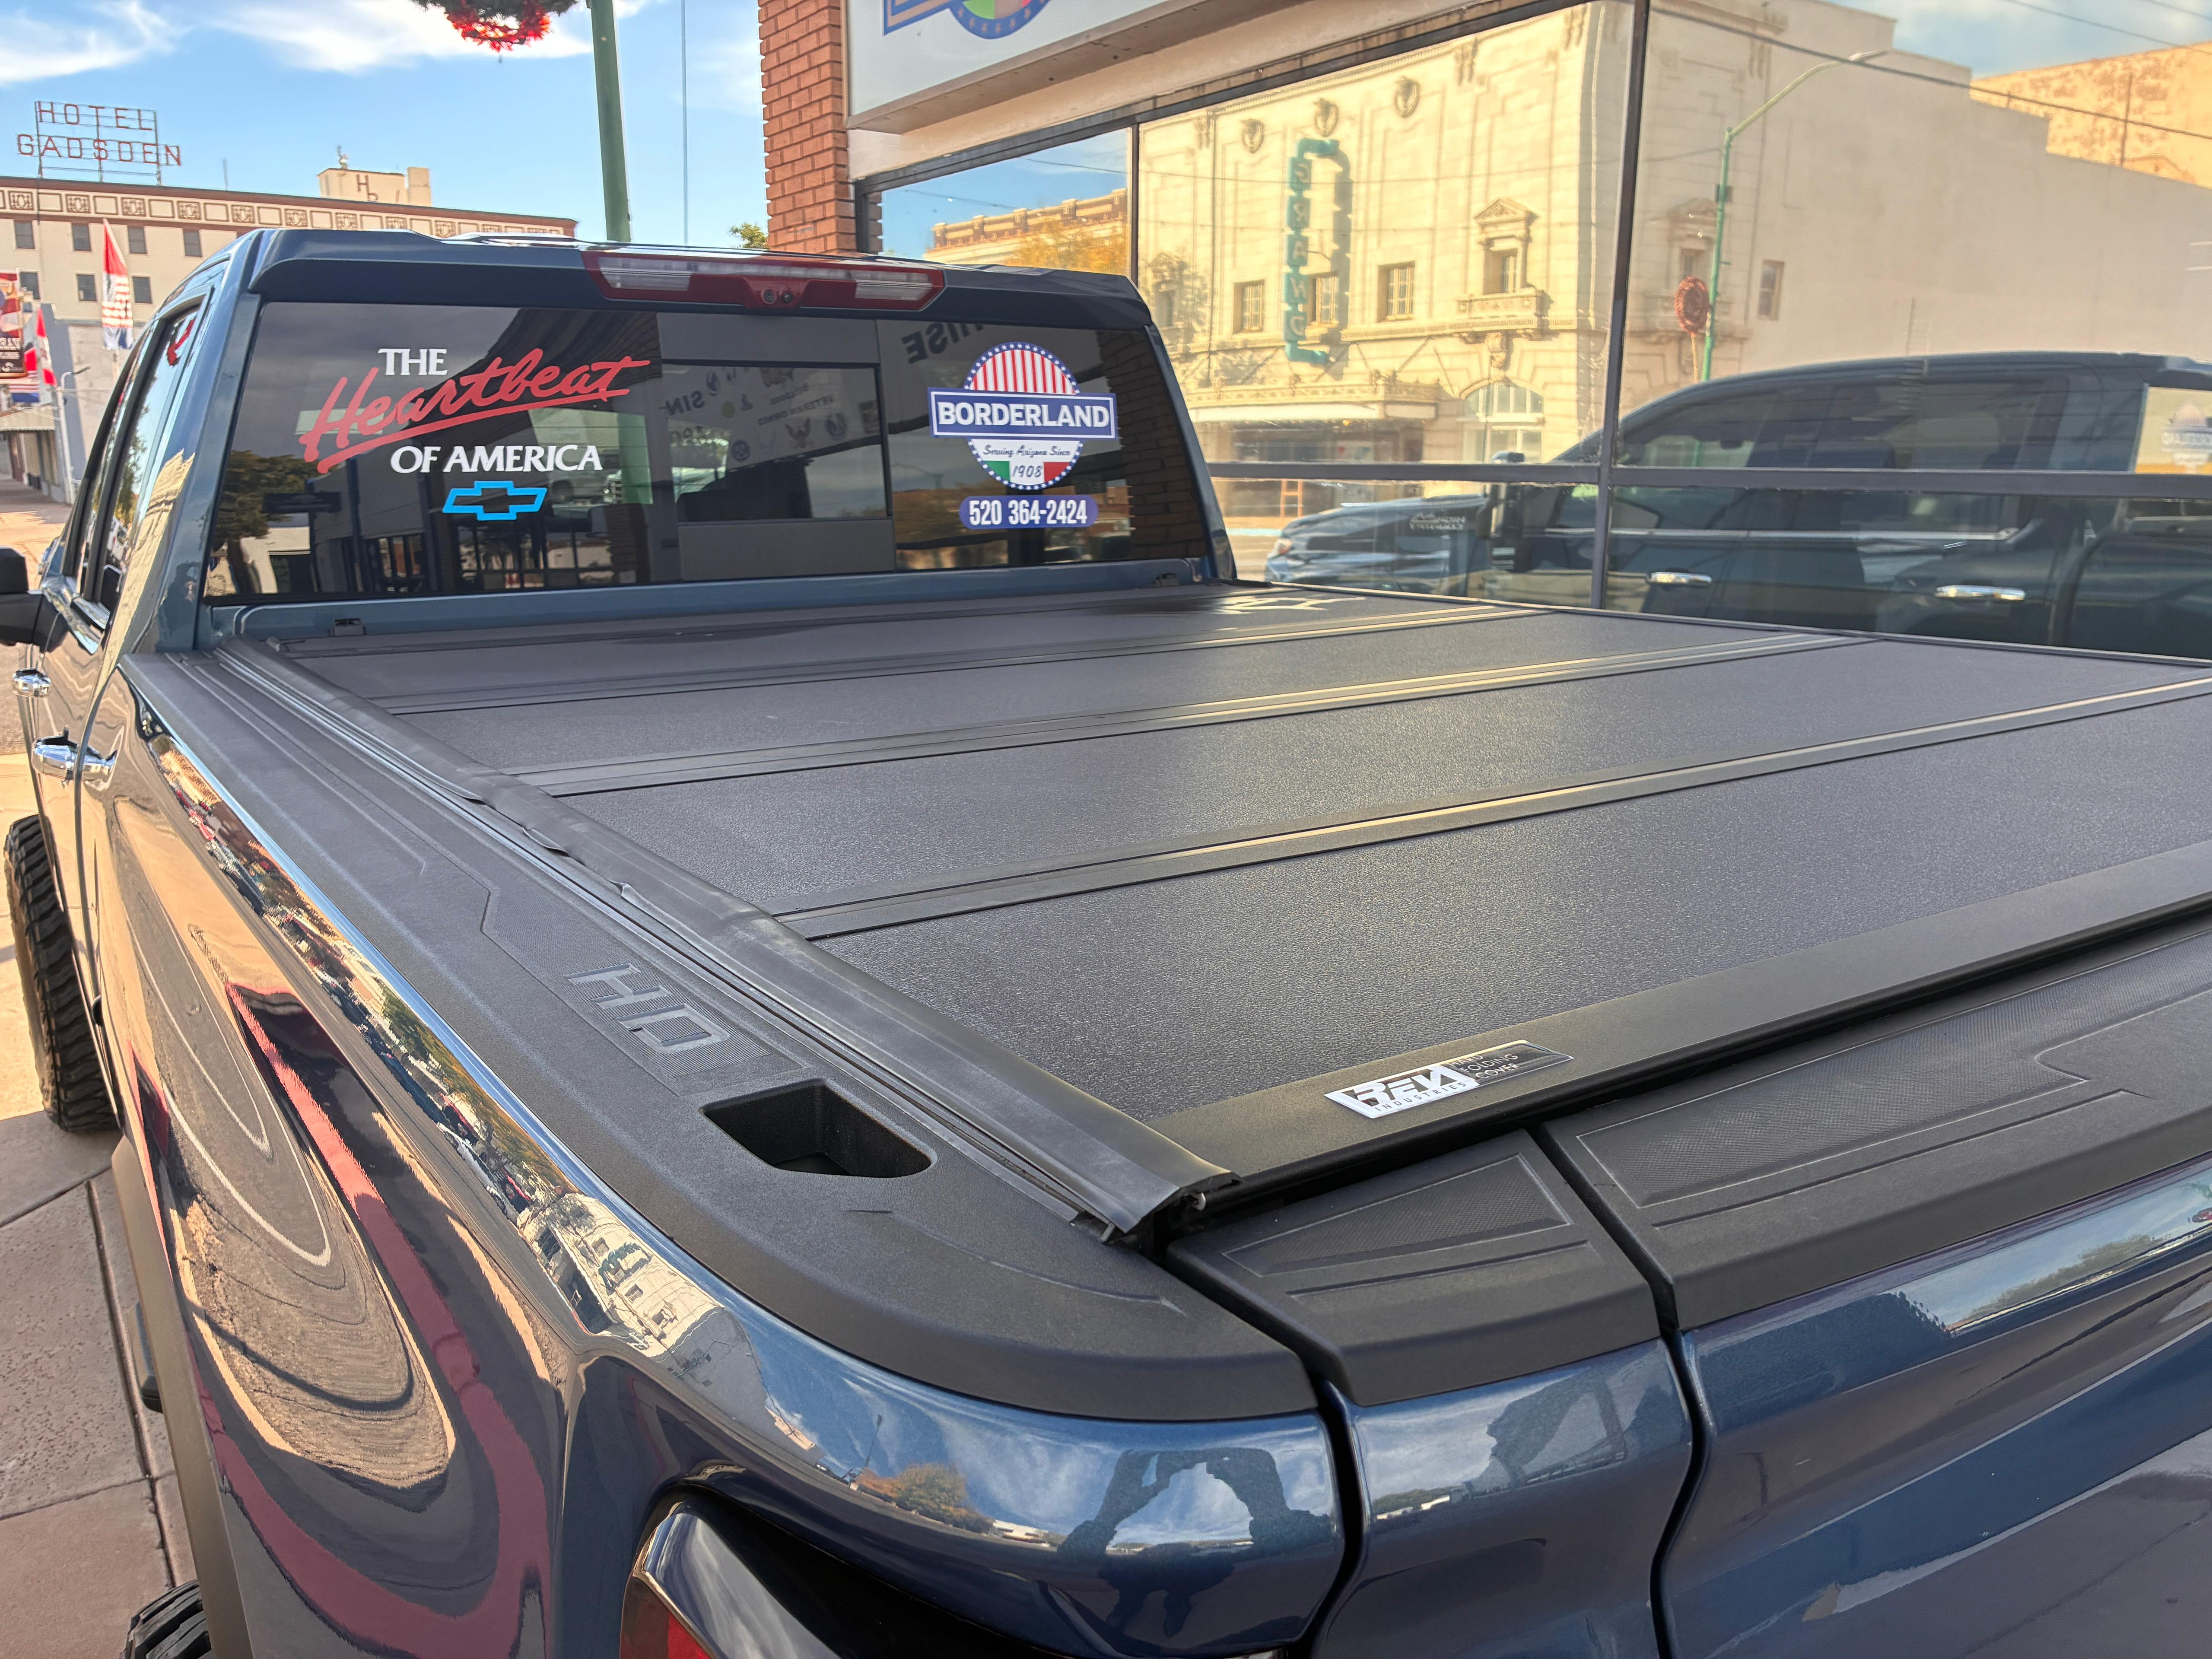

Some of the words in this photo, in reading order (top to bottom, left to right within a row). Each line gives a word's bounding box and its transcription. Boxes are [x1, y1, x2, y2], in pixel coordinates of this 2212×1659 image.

[38, 100, 153, 131] HOTEL
[17, 134, 181, 166] GADSDEN
[378, 348, 447, 376] THE
[299, 348, 651, 463] Heartbeat
[937, 402, 1110, 427] BORDERLAND
[390, 445, 440, 474] OF
[443, 445, 603, 473] AMERICA
[1012, 464, 1043, 478] 1908
[969, 500, 1002, 525] 520
[1008, 499, 1087, 524] 364-2424
[564, 963, 730, 1054] HD
[1446, 1055, 1484, 1067] HARD
[1460, 1054, 1519, 1073] FOLDING
[1475, 1063, 1520, 1079] COVER
[1374, 1081, 1467, 1112] INDUSTRIES
